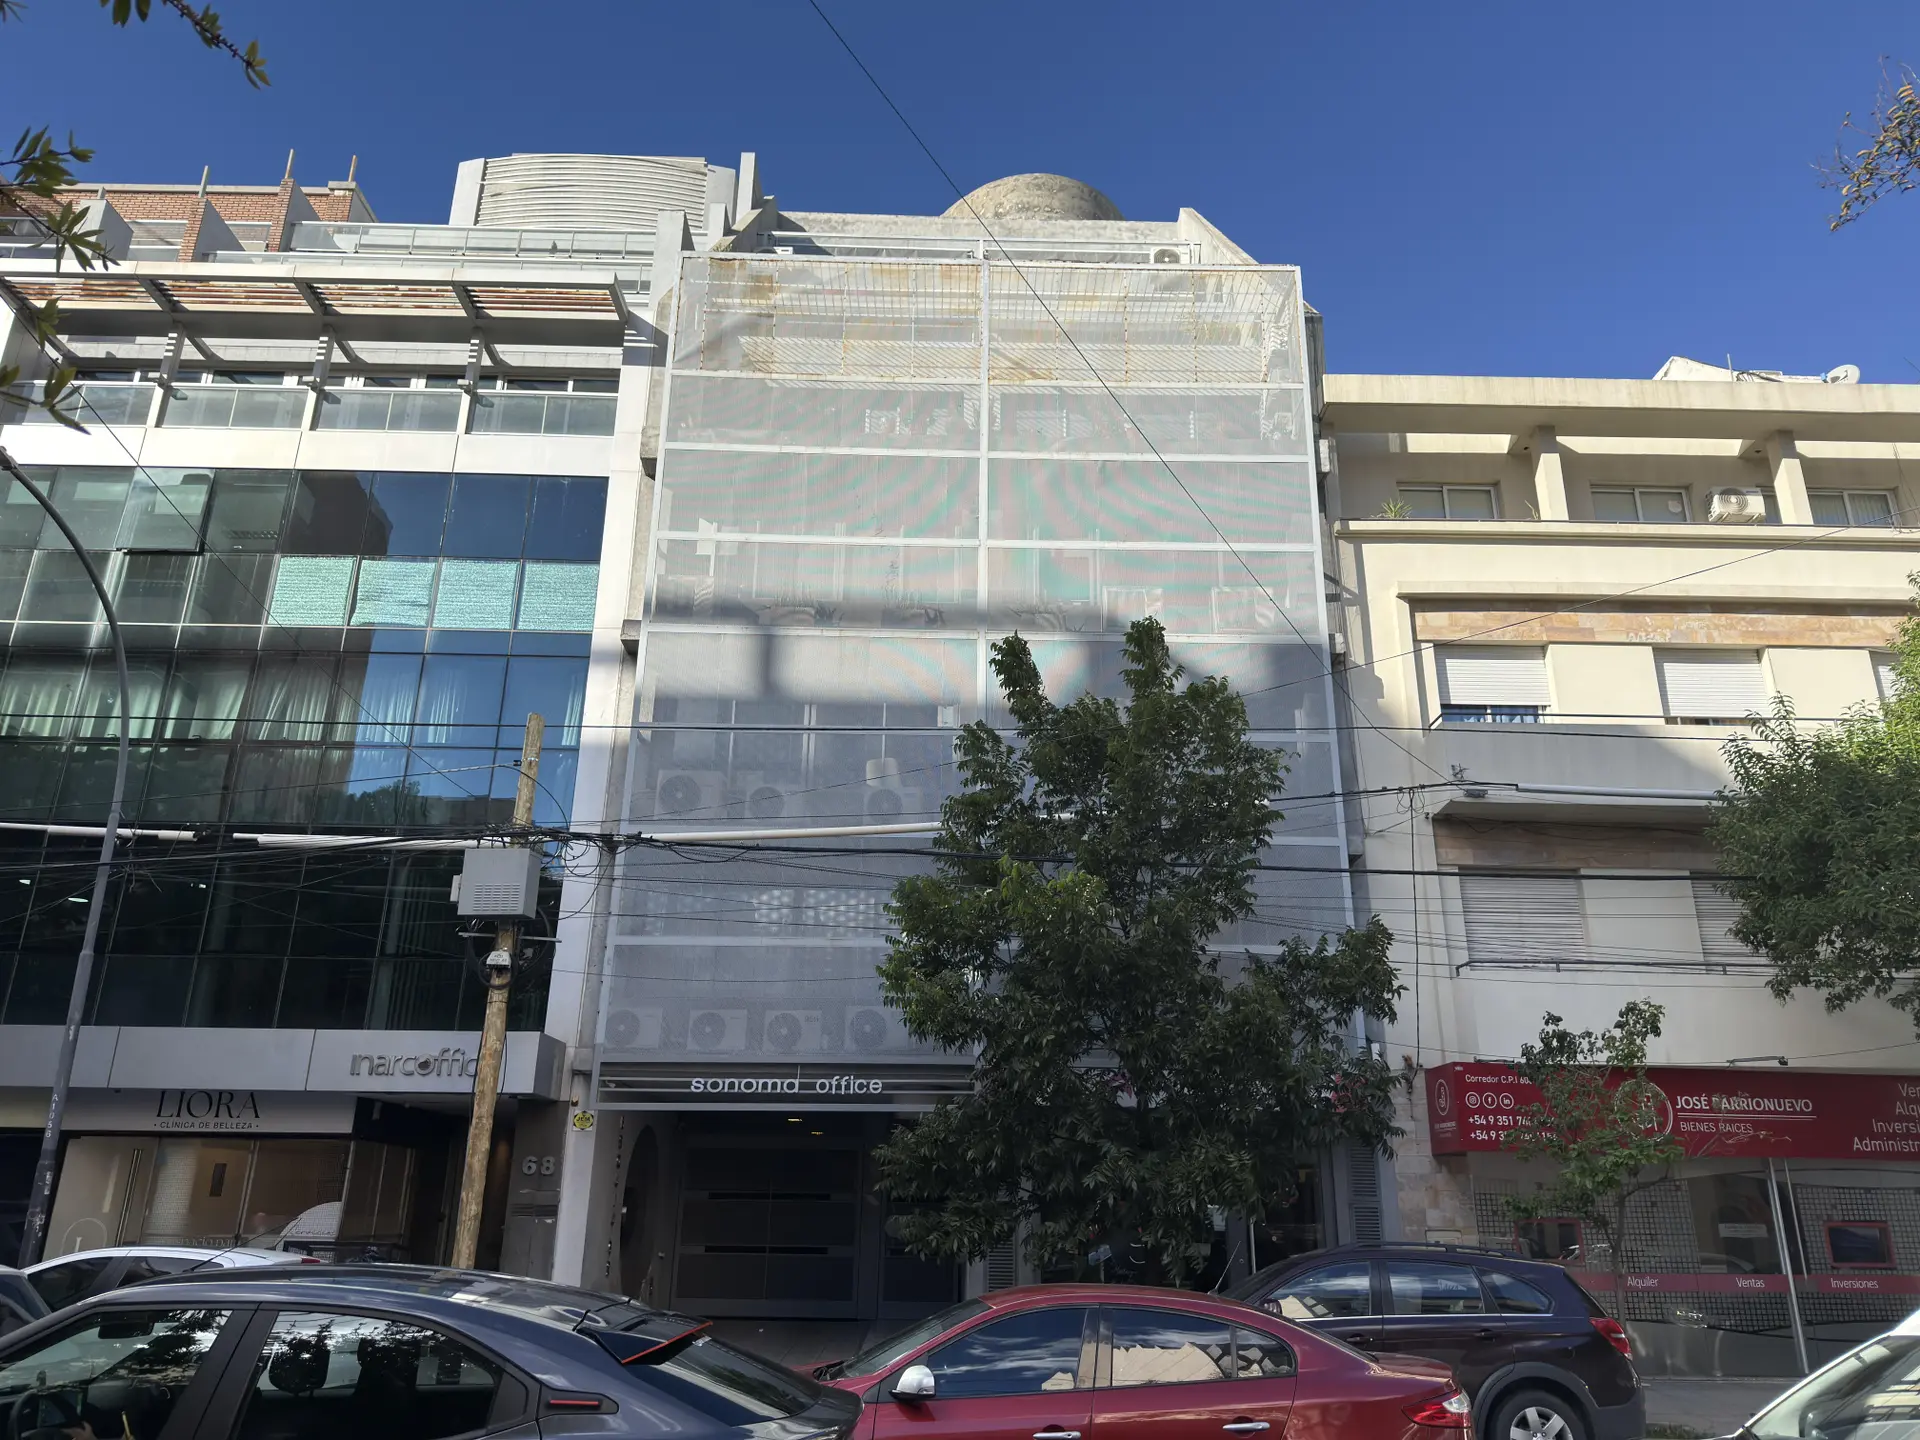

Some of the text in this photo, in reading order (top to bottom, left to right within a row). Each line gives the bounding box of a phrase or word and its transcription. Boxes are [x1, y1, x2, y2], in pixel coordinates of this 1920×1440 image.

[1465, 1074, 1499, 1083] Corredor
[815, 1075, 883, 1095] office
[156, 1090, 260, 1118] LIORA
[1675, 1094, 1710, 1110] JOSÉ
[1896, 1100, 1920, 1118] Alq
[1468, 1115, 1487, 1126] +54
[1489, 1115, 1495, 1125] 9
[1497, 1115, 1513, 1126] 351
[1680, 1121, 1716, 1133] BIENES
[1470, 1130, 1488, 1140] +54
[1490, 1131, 1496, 1140] 9
[522, 1156, 555, 1175] 68
[1627, 1277, 1659, 1288] Alquiler
[1735, 1277, 1765, 1288] Ventas
[1831, 1277, 1879, 1290] Inversiones
